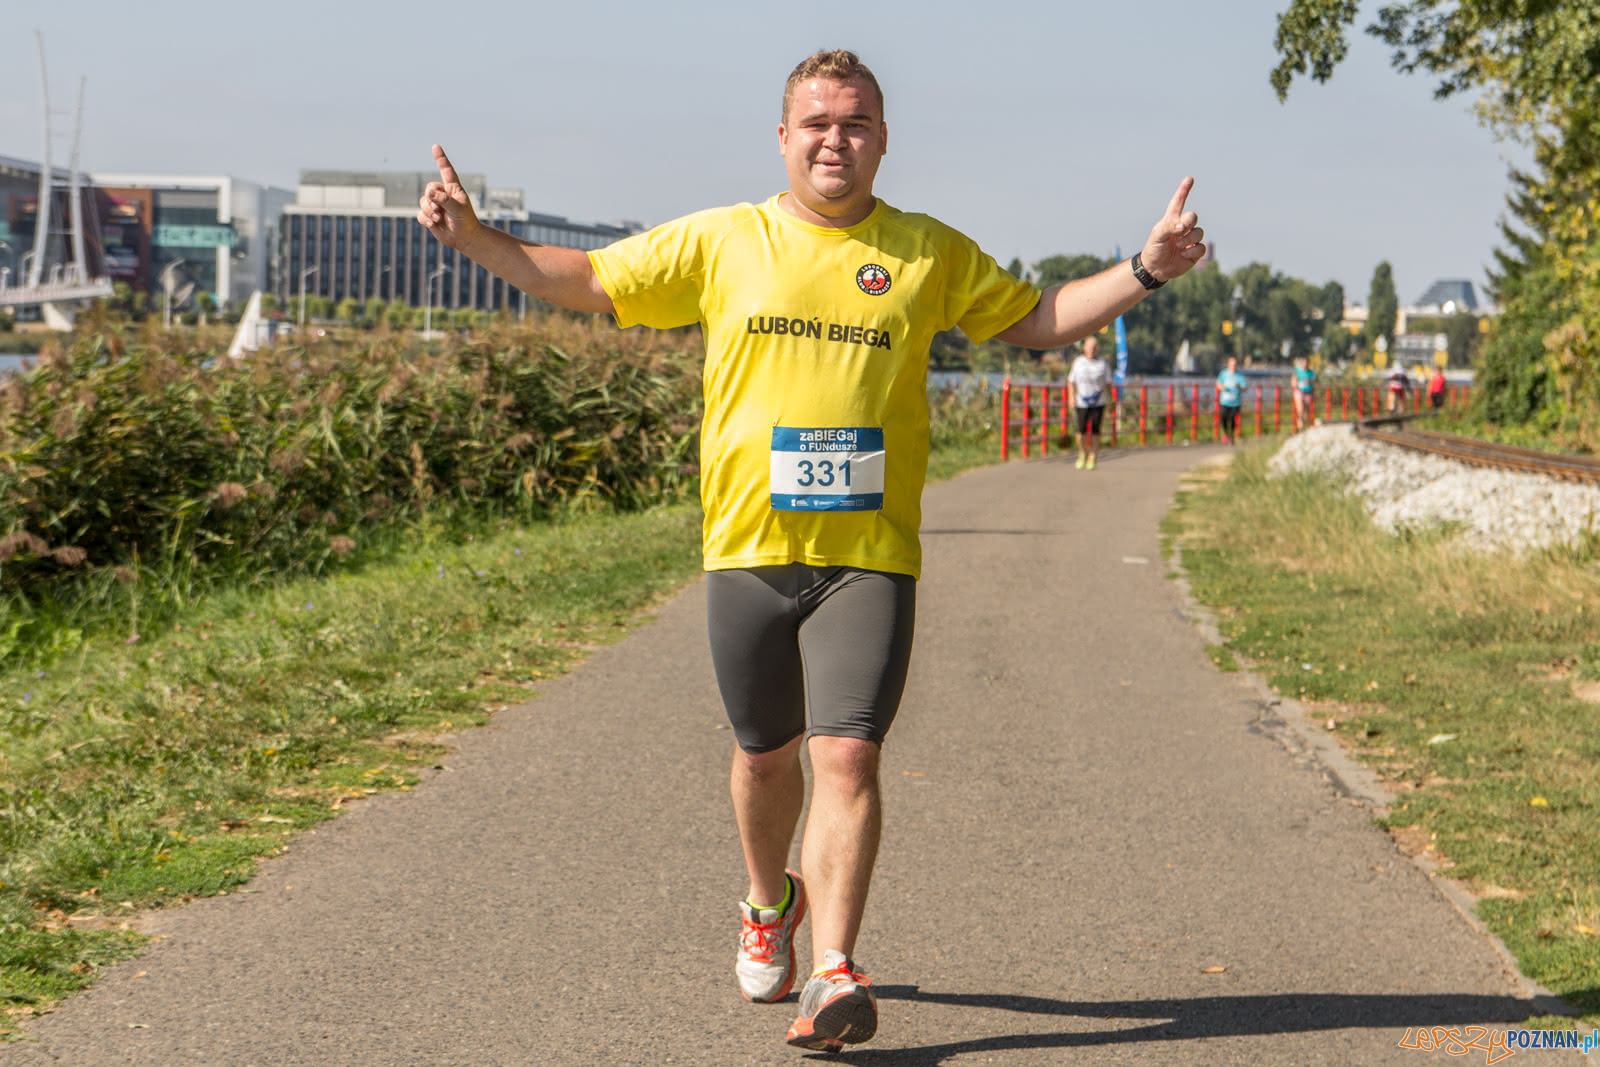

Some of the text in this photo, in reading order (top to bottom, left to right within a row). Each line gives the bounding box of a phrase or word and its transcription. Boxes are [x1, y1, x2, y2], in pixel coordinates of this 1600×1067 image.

[747, 316, 892, 350] LUBOŃ BIEGA
[799, 429, 857, 443] zaBIEGaj
[799, 442, 857, 452] o FUNdusze
[797, 459, 851, 487] 331
